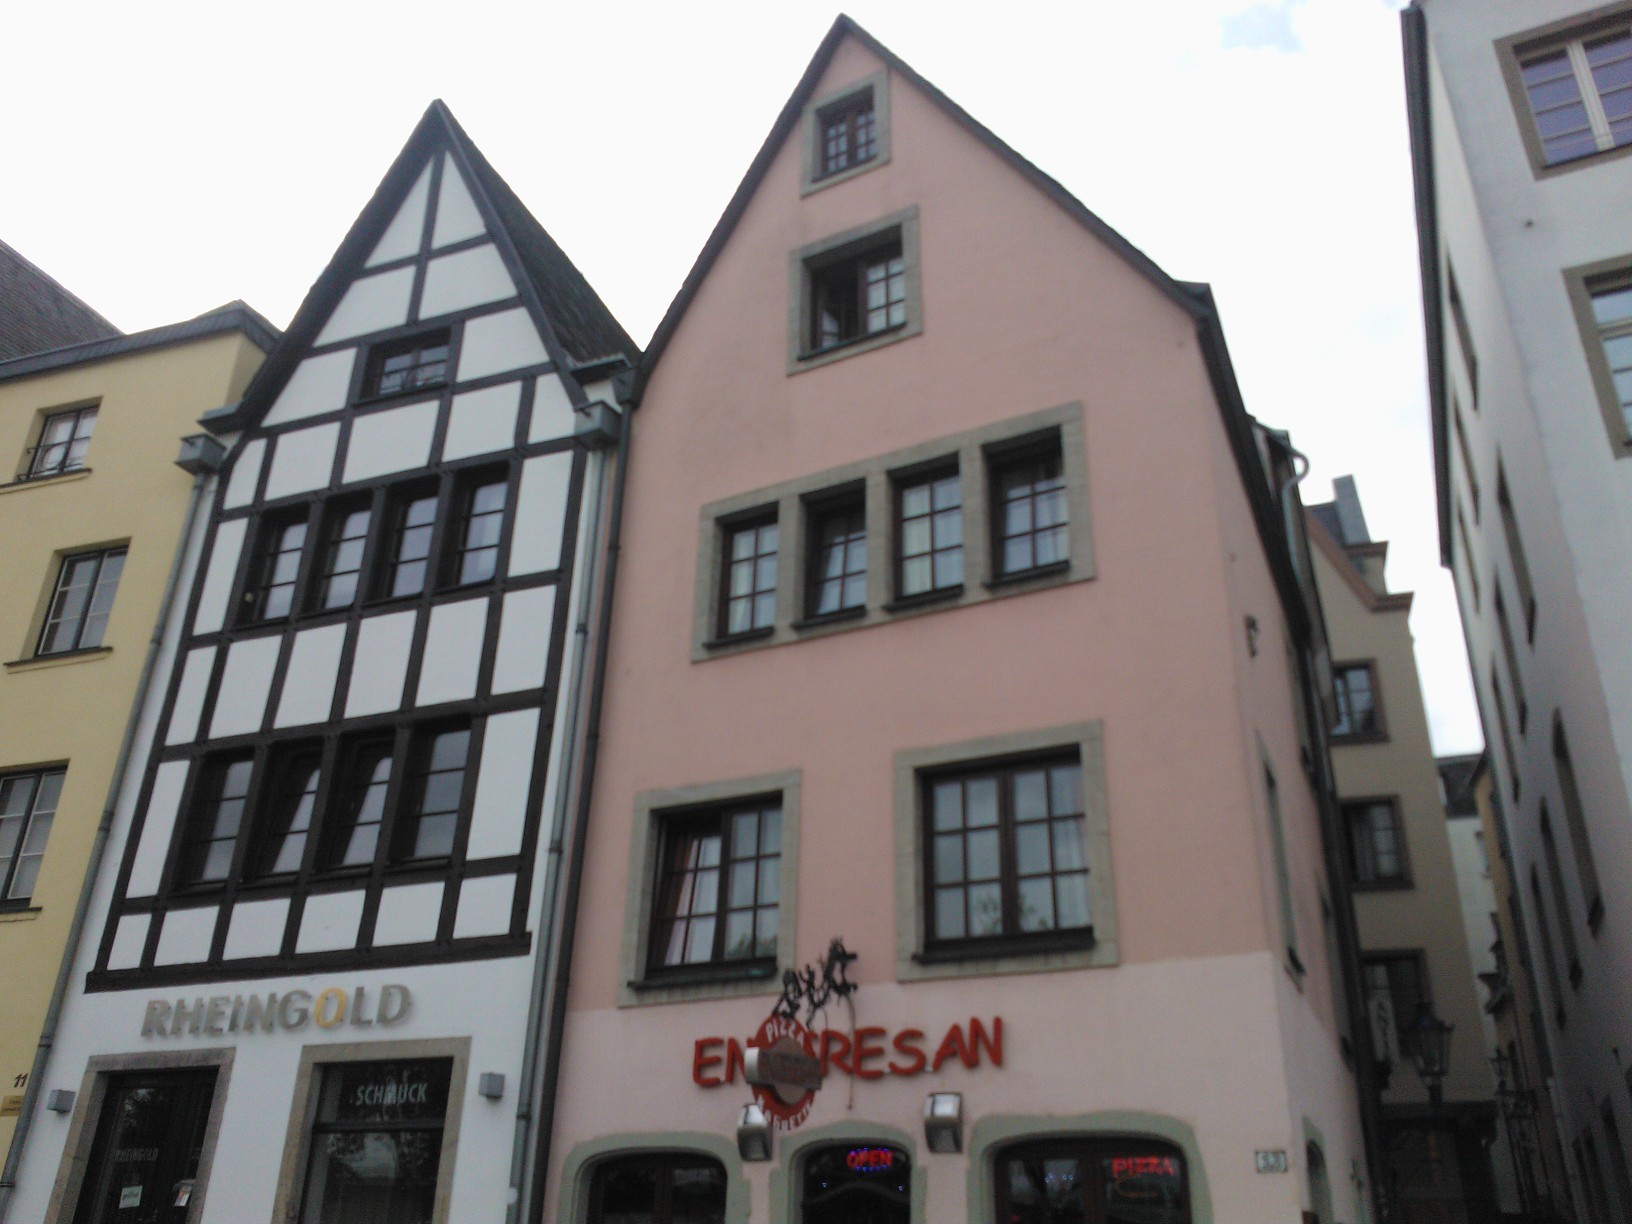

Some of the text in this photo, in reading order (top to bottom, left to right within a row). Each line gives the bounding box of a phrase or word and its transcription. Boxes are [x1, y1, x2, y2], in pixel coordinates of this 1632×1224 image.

[140, 984, 412, 1037] RHEINGOLD
[765, 1018, 805, 1045] PIZZA
[693, 1015, 1004, 1087] ENRESAN
[13, 1072, 28, 1088] 11
[355, 1082, 428, 1106] SCHMUCK
[846, 1149, 893, 1168] OPEN
[1111, 1156, 1175, 1177] PIZZA
